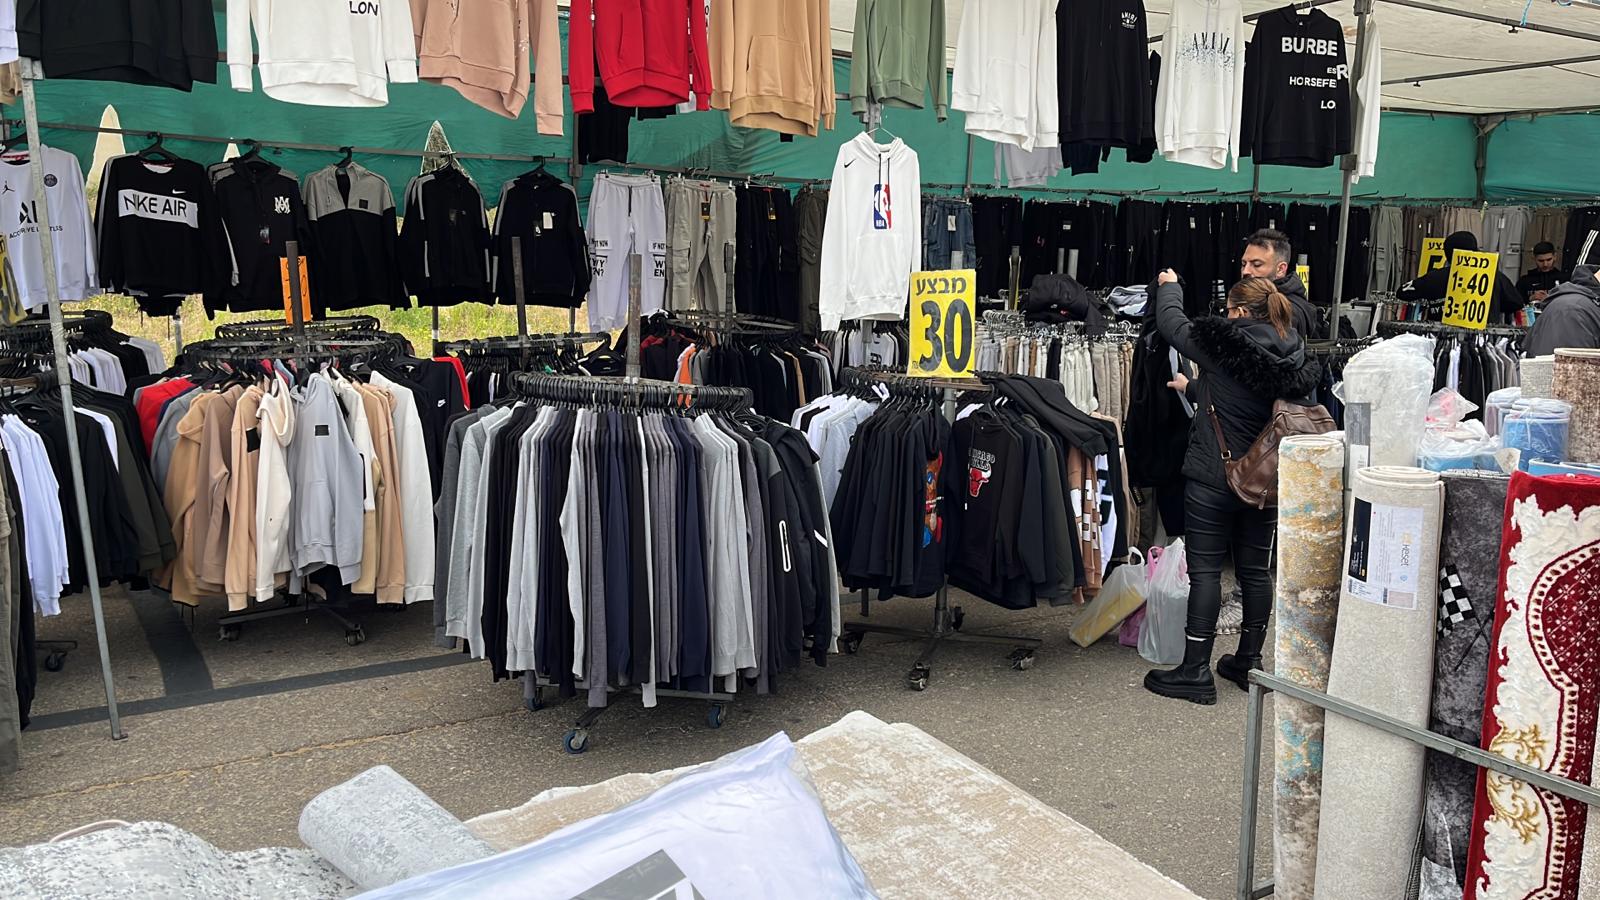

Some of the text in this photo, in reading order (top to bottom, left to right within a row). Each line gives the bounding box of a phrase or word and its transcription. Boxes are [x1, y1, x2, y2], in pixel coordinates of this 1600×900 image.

[349, 1, 378, 16] LON
[1281, 37, 1338, 57] BURBE
[1289, 76, 1337, 88] HORSEFE
[161, 199, 187, 218] AIR
[1456, 254, 1490, 269] מבצע
[916, 277, 967, 296] מבצע
[918, 298, 973, 374] 30
